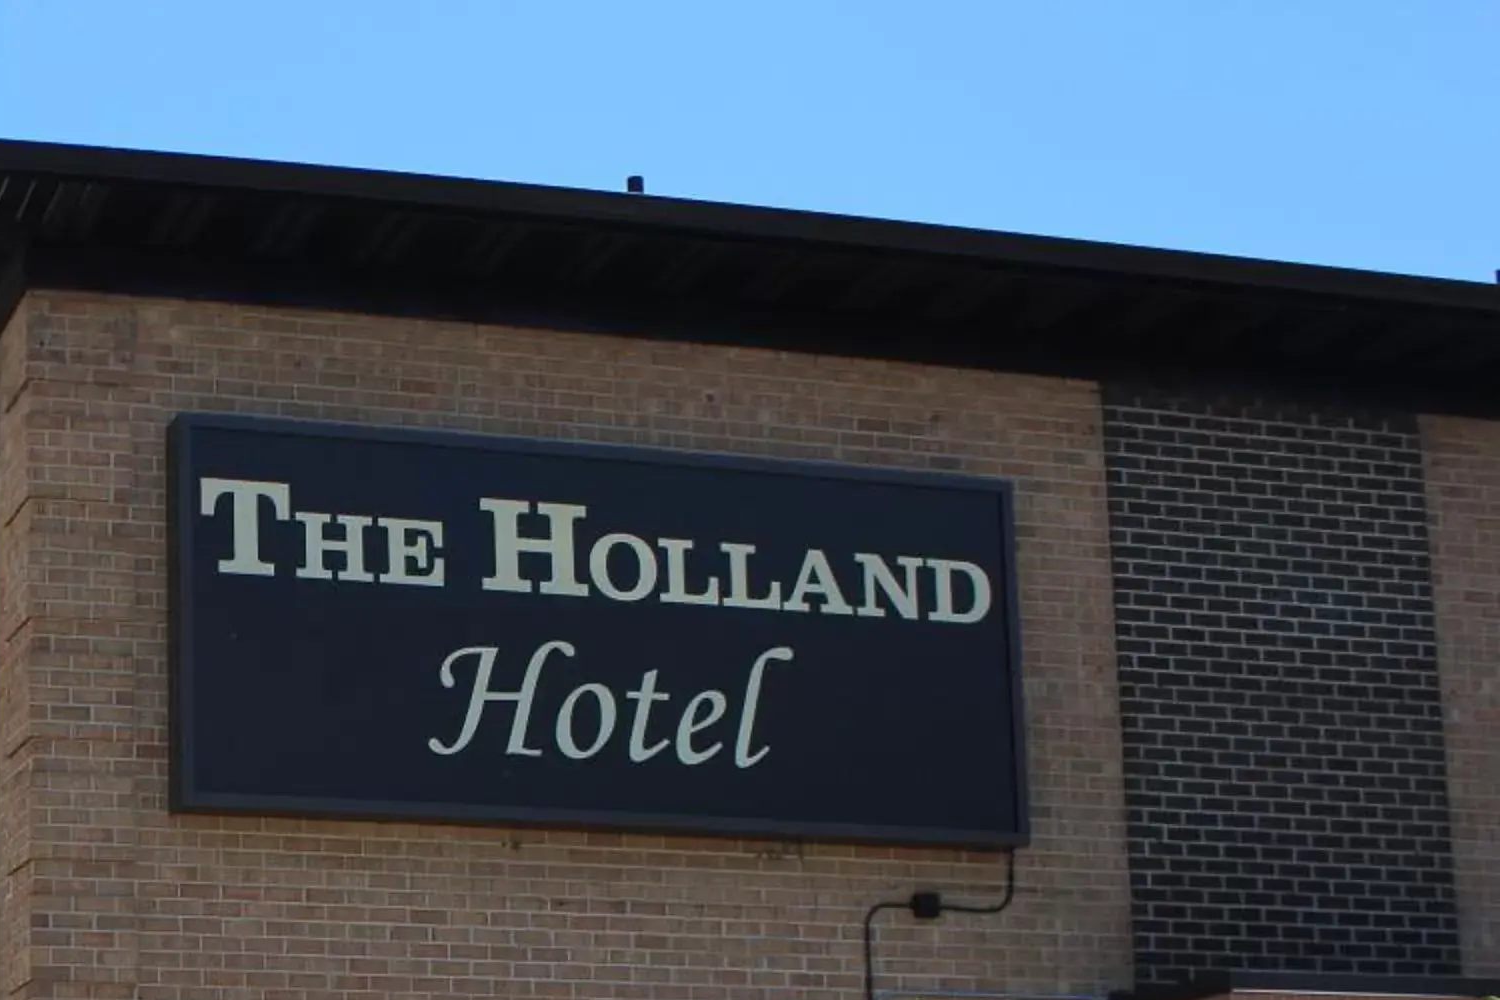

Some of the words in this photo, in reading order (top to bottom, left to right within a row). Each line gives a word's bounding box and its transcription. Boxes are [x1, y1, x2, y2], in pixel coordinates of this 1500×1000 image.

[200, 477, 445, 587] THE
[479, 497, 992, 624] HOLLAND
[428, 640, 794, 768] Hotel
